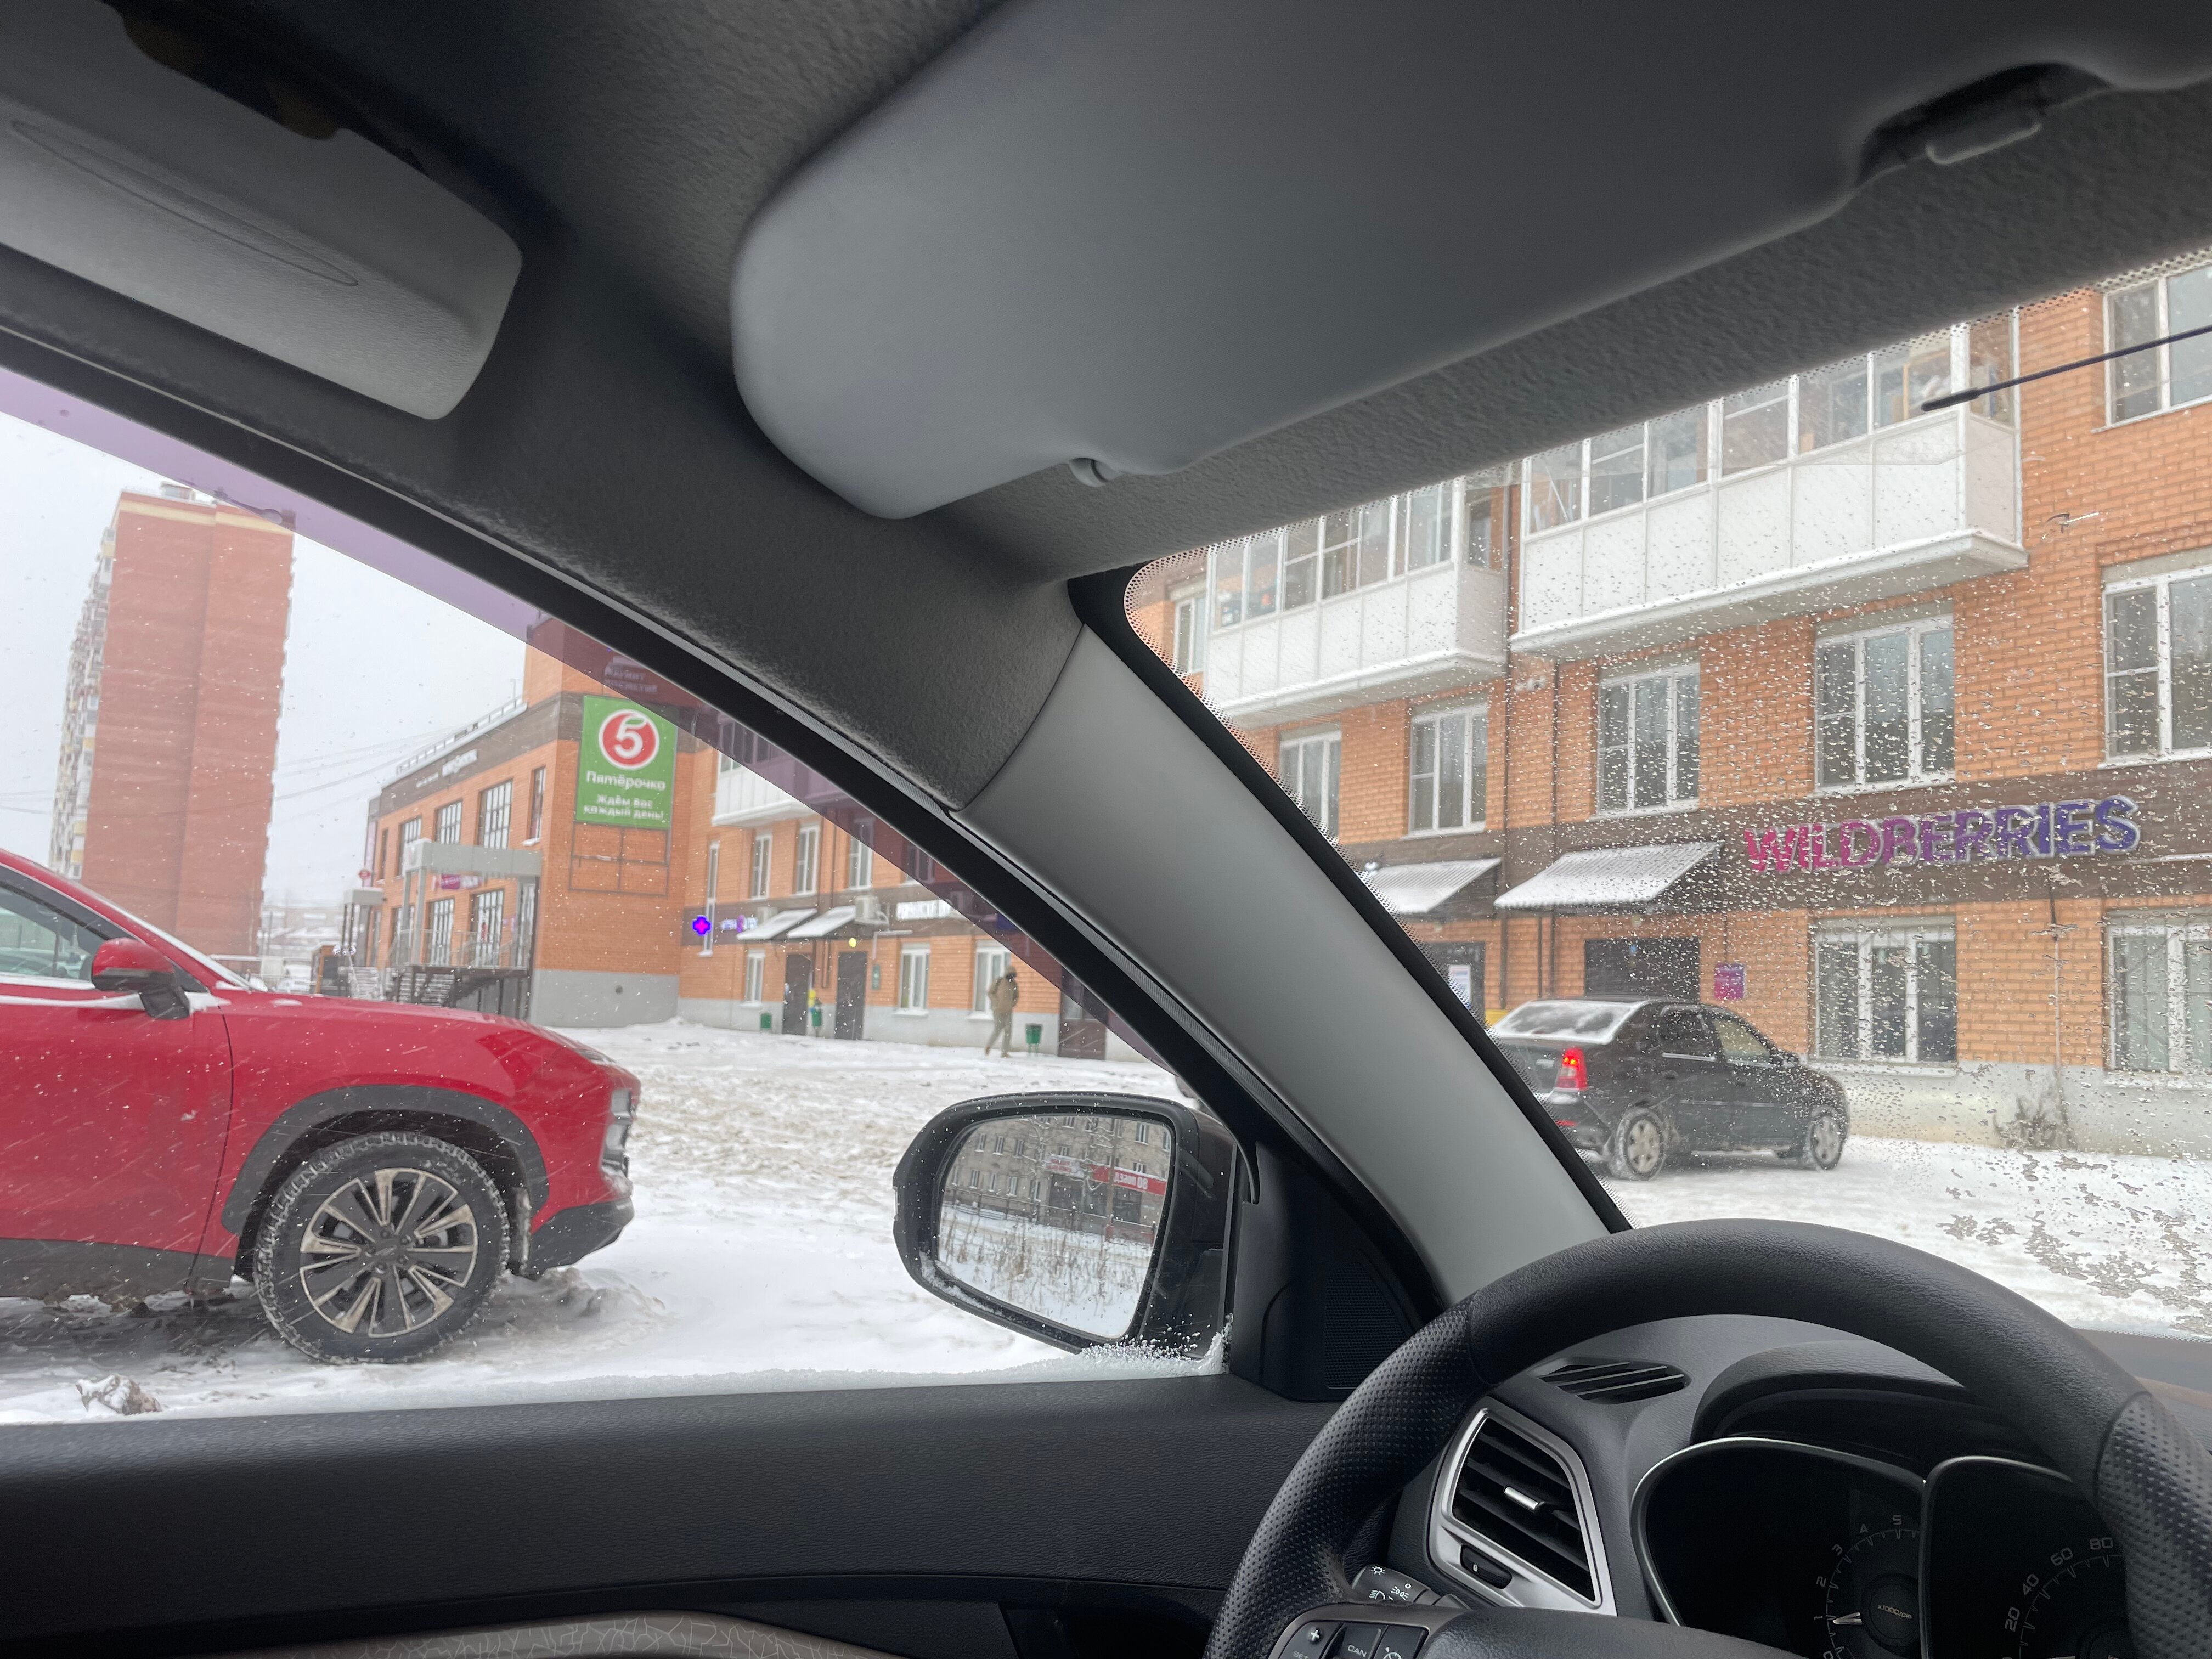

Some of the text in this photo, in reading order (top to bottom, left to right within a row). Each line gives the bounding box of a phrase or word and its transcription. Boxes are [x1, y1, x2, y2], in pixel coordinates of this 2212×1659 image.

[586, 770, 665, 791] Пятёрочка
[597, 794, 631, 806] Ждём
[583, 805, 663, 820] каждый день!
[1744, 795, 2142, 873] WILDBERRIES
[1893, 1515, 1903, 1525] 5
[1859, 1523, 1868, 1533] 4
[1832, 1544, 1843, 1556] 3
[2089, 1537, 2114, 1550] 80
[2050, 1547, 2073, 1566] 60
[1816, 1576, 1827, 1587] 2
[2022, 1573, 2039, 1596] 40
[2004, 1607, 2021, 1632] 20
[1347, 1645, 1367, 1658] CAN
